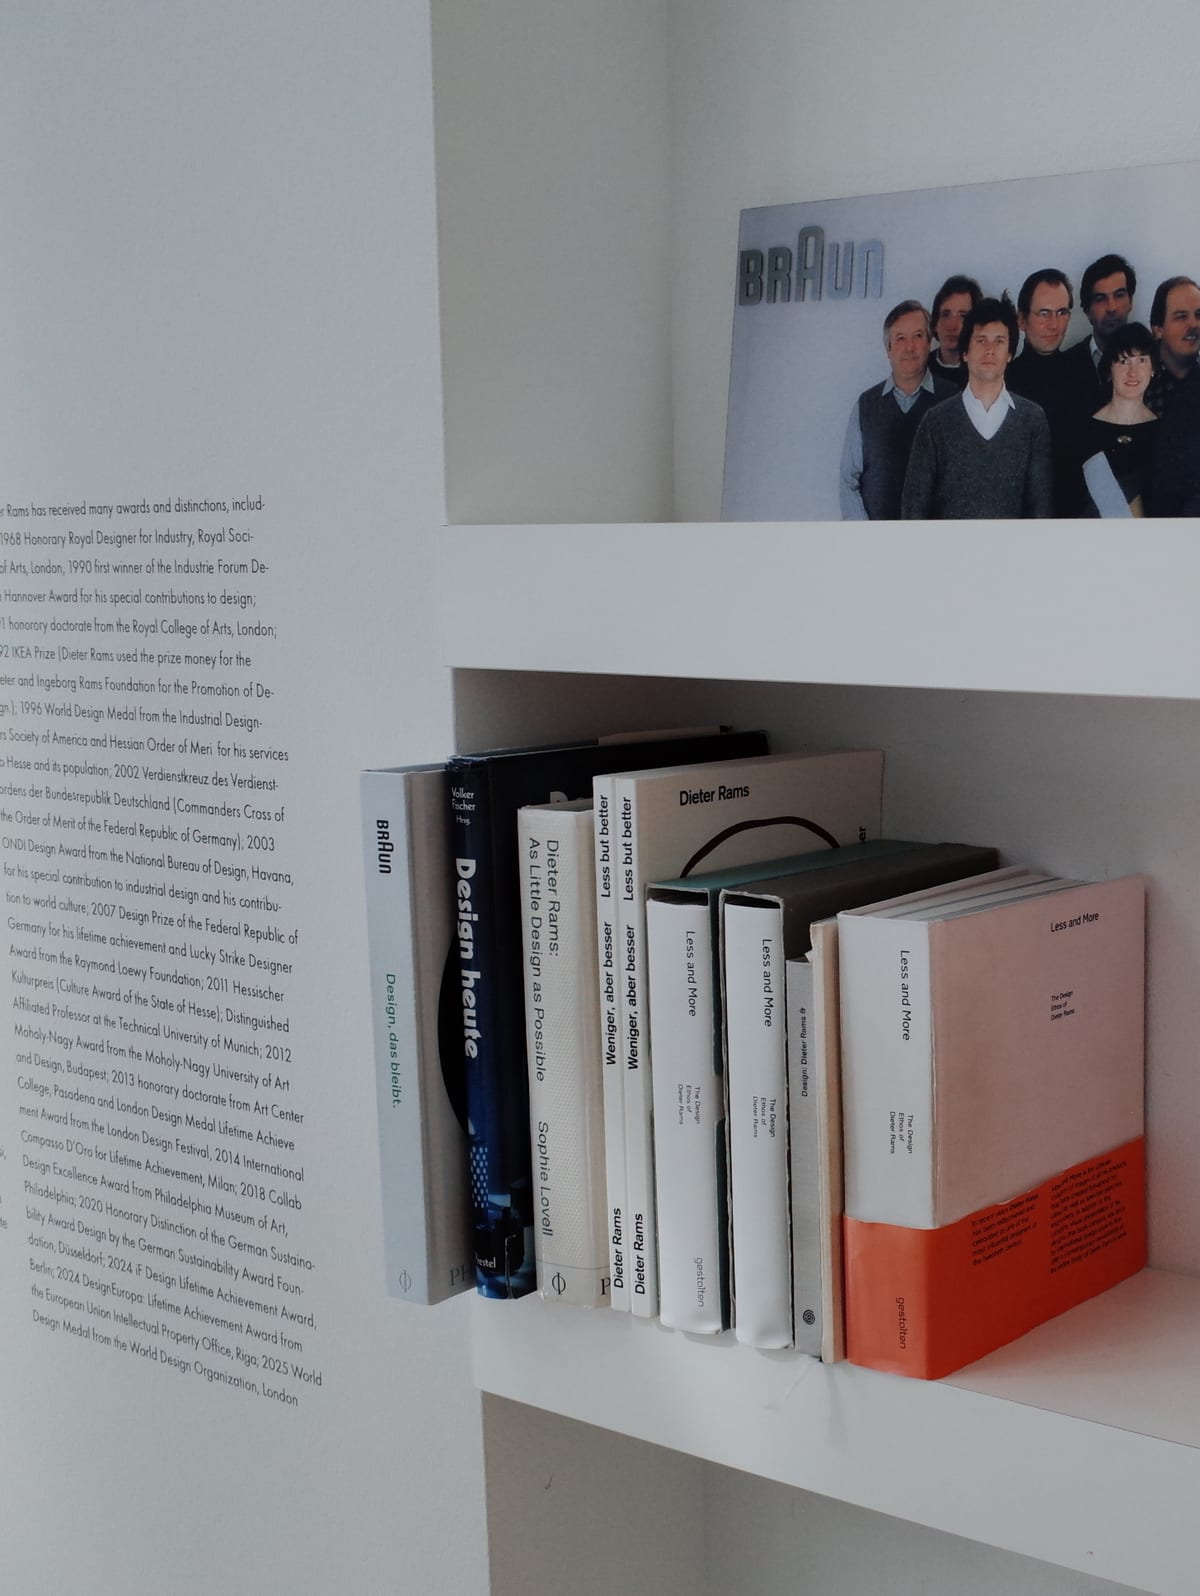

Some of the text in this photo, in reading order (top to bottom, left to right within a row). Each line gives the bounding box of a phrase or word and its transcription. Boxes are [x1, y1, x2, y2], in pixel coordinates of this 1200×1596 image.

[737, 225, 884, 306] BRAUN
[23, 531, 66, 549] Honorary
[68, 528, 94, 549] Royal
[95, 527, 137, 549] Designer
[138, 527, 152, 544] for
[197, 526, 227, 547] Royal
[3, 588, 47, 603] Hannover
[47, 587, 78, 603] Award
[79, 587, 94, 605] for
[94, 587, 107, 603] his
[108, 587, 142, 608] special
[144, 585, 205, 608] contributions
[206, 591, 217, 608] to
[8, 727, 40, 747] Society
[41, 728, 50, 744] of
[51, 730, 88, 747] America
[89, 732, 108, 752] and
[109, 733, 145, 752] Hessian
[146, 735, 176, 753] Order
[177, 737, 188, 754] of
[216, 740, 231, 760] for
[232, 741, 247, 760] his
[248, 743, 289, 764] services
[451, 787, 475, 800] Volker
[452, 800, 476, 812] Fischer
[679, 785, 749, 806] Dieter Rams
[1, 836, 26, 851] ONDI
[27, 838, 56, 858] Design
[57, 842, 87, 864] Award
[88, 844, 108, 861] from
[109, 847, 124, 863] the
[125, 849, 165, 871] National
[166, 854, 200, 872] Bureau
[201, 857, 212, 875] of
[376, 819, 393, 874] BRAUN
[598, 794, 611, 897] Less but better
[621, 796, 633, 901] Less but better
[546, 839, 560, 956] Dieter Rams:
[1050, 912, 1099, 932] Less and More
[455, 858, 482, 1058] Design heute
[529, 837, 546, 1081] As Little Design as Possible
[602, 921, 617, 1065] Weniger, aber besser
[685, 930, 698, 1016] Less and More
[762, 938, 774, 1027] Less and More
[900, 950, 911, 1040] Less and More
[625, 924, 639, 1070] Weniger, aber besser
[14, 1023, 290, 1092] Moholy-Nagy Award from the Moholy-Nagy University of Art
[389, 1032, 399, 1058] das
[390, 1062, 402, 1108] bleibt.
[898, 1133, 905, 1142] of
[536, 1120, 553, 1236] Sophie Lovell
[78, 1194, 103, 1215] 2020
[104, 1200, 148, 1229] Honorary
[150, 1212, 197, 1239] Distinction
[198, 1226, 209, 1242] of
[210, 1228, 226, 1247] the
[227, 1232, 268, 1259] German
[611, 1207, 623, 1288] Dieter Rams
[633, 1213, 645, 1294] Dieter Rams
[107, 1254, 133, 1275] 2024
[134, 1263, 143, 1278] iF
[144, 1264, 176, 1289] Design
[178, 1274, 214, 1298] Lifetime
[216, 1285, 278, 1317] Achievement
[32, 1308, 60, 1332] Design
[62, 1319, 91, 1340] Medal
[92, 1326, 112, 1347] from
[113, 1334, 128, 1352] the
[128, 1339, 158, 1361] World
[159, 1348, 193, 1374] Design
[260, 1381, 298, 1407] London
